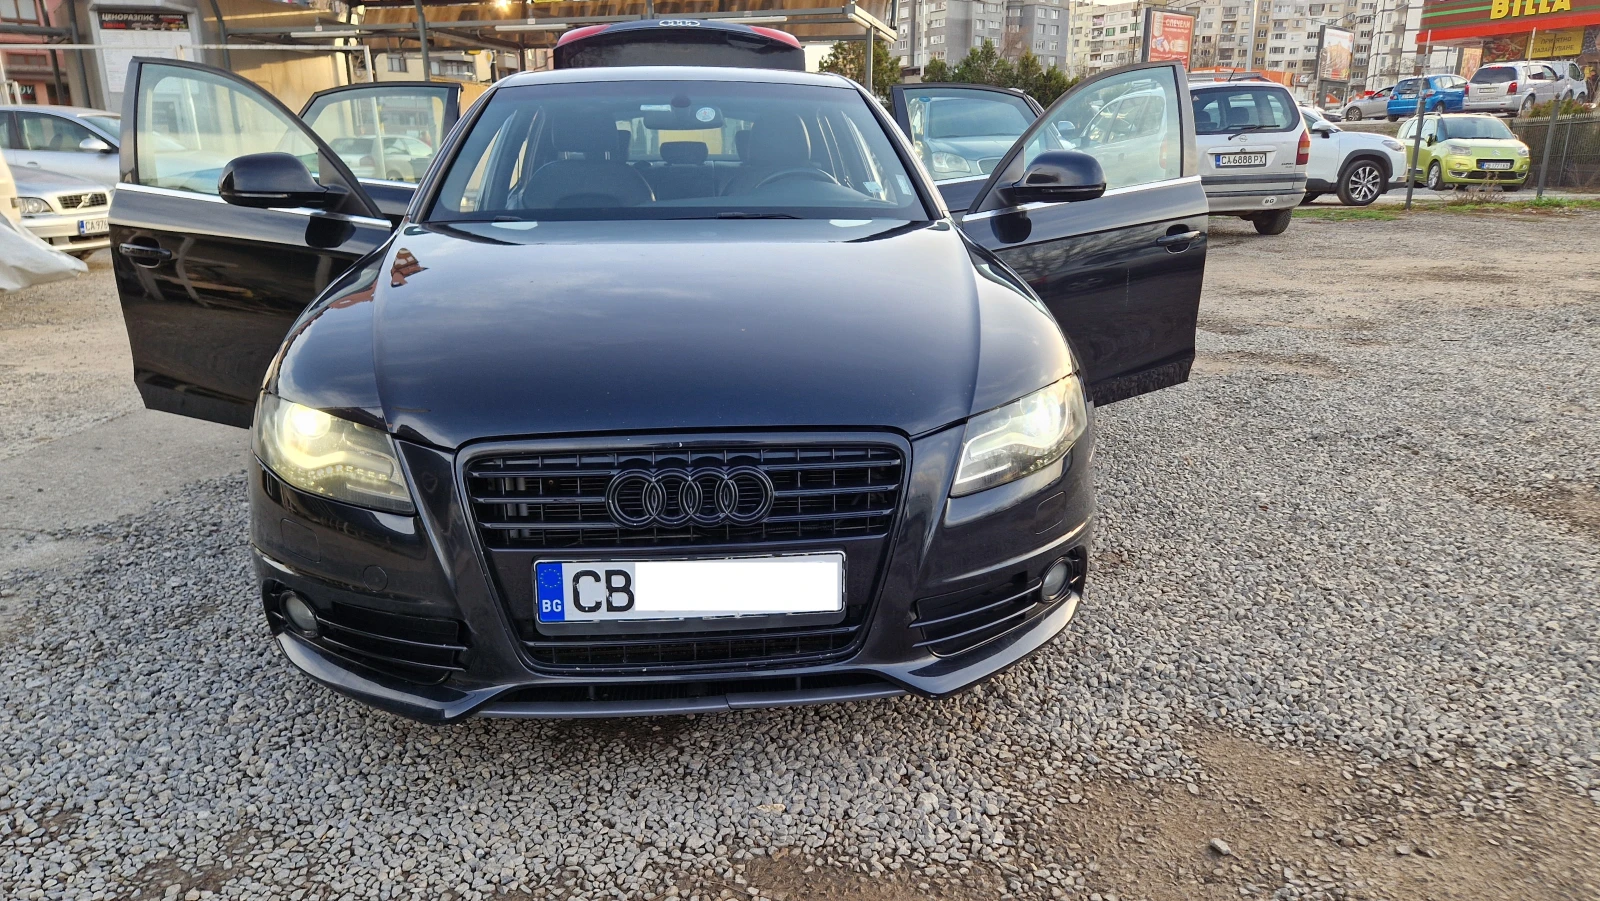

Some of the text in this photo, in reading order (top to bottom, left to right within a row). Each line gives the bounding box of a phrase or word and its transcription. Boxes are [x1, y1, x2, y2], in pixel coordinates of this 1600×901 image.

[102, 13, 154, 21] ЦЕНОРАЗПИС
[1490, 0, 1570, 19] BILLA
[572, 569, 635, 613] CB
[541, 599, 562, 613] BG
